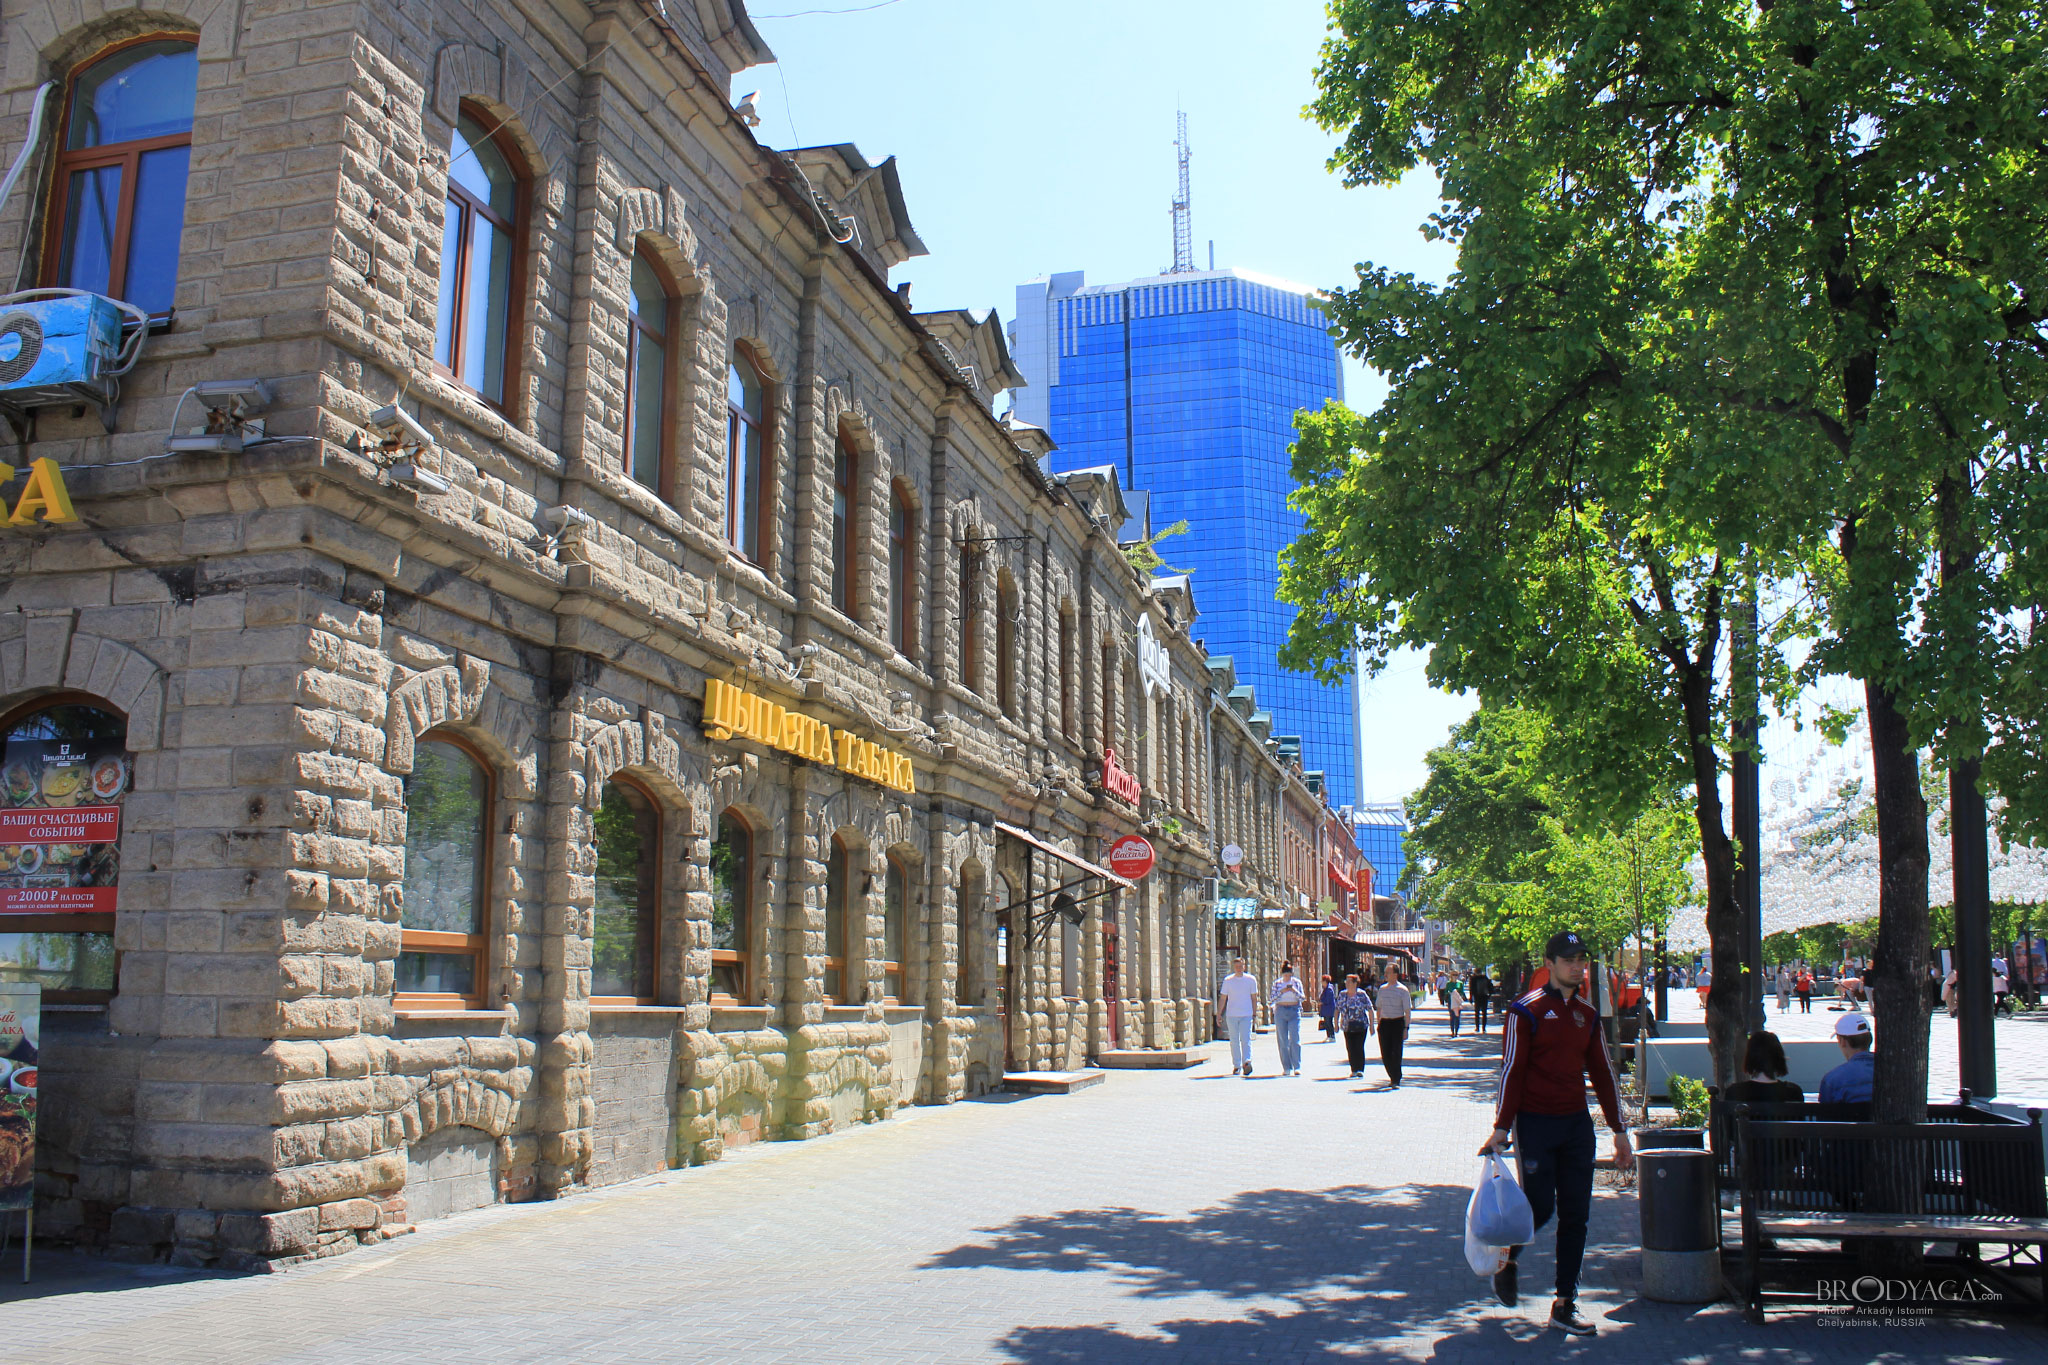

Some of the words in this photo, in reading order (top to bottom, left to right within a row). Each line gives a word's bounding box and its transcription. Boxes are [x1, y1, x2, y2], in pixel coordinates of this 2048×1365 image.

[703, 679, 834, 765] ЦЫПЛЯТА
[834, 729, 916, 794] ТАБАКА
[3, 815, 37, 826] ВАШИ
[40, 812, 115, 825] СЧАСТЛИВЫЕ
[29, 826, 85, 837] СОБЫТИЯ
[19, 890, 48, 902] 2000
[72, 893, 95, 901] ГОСТЯ
